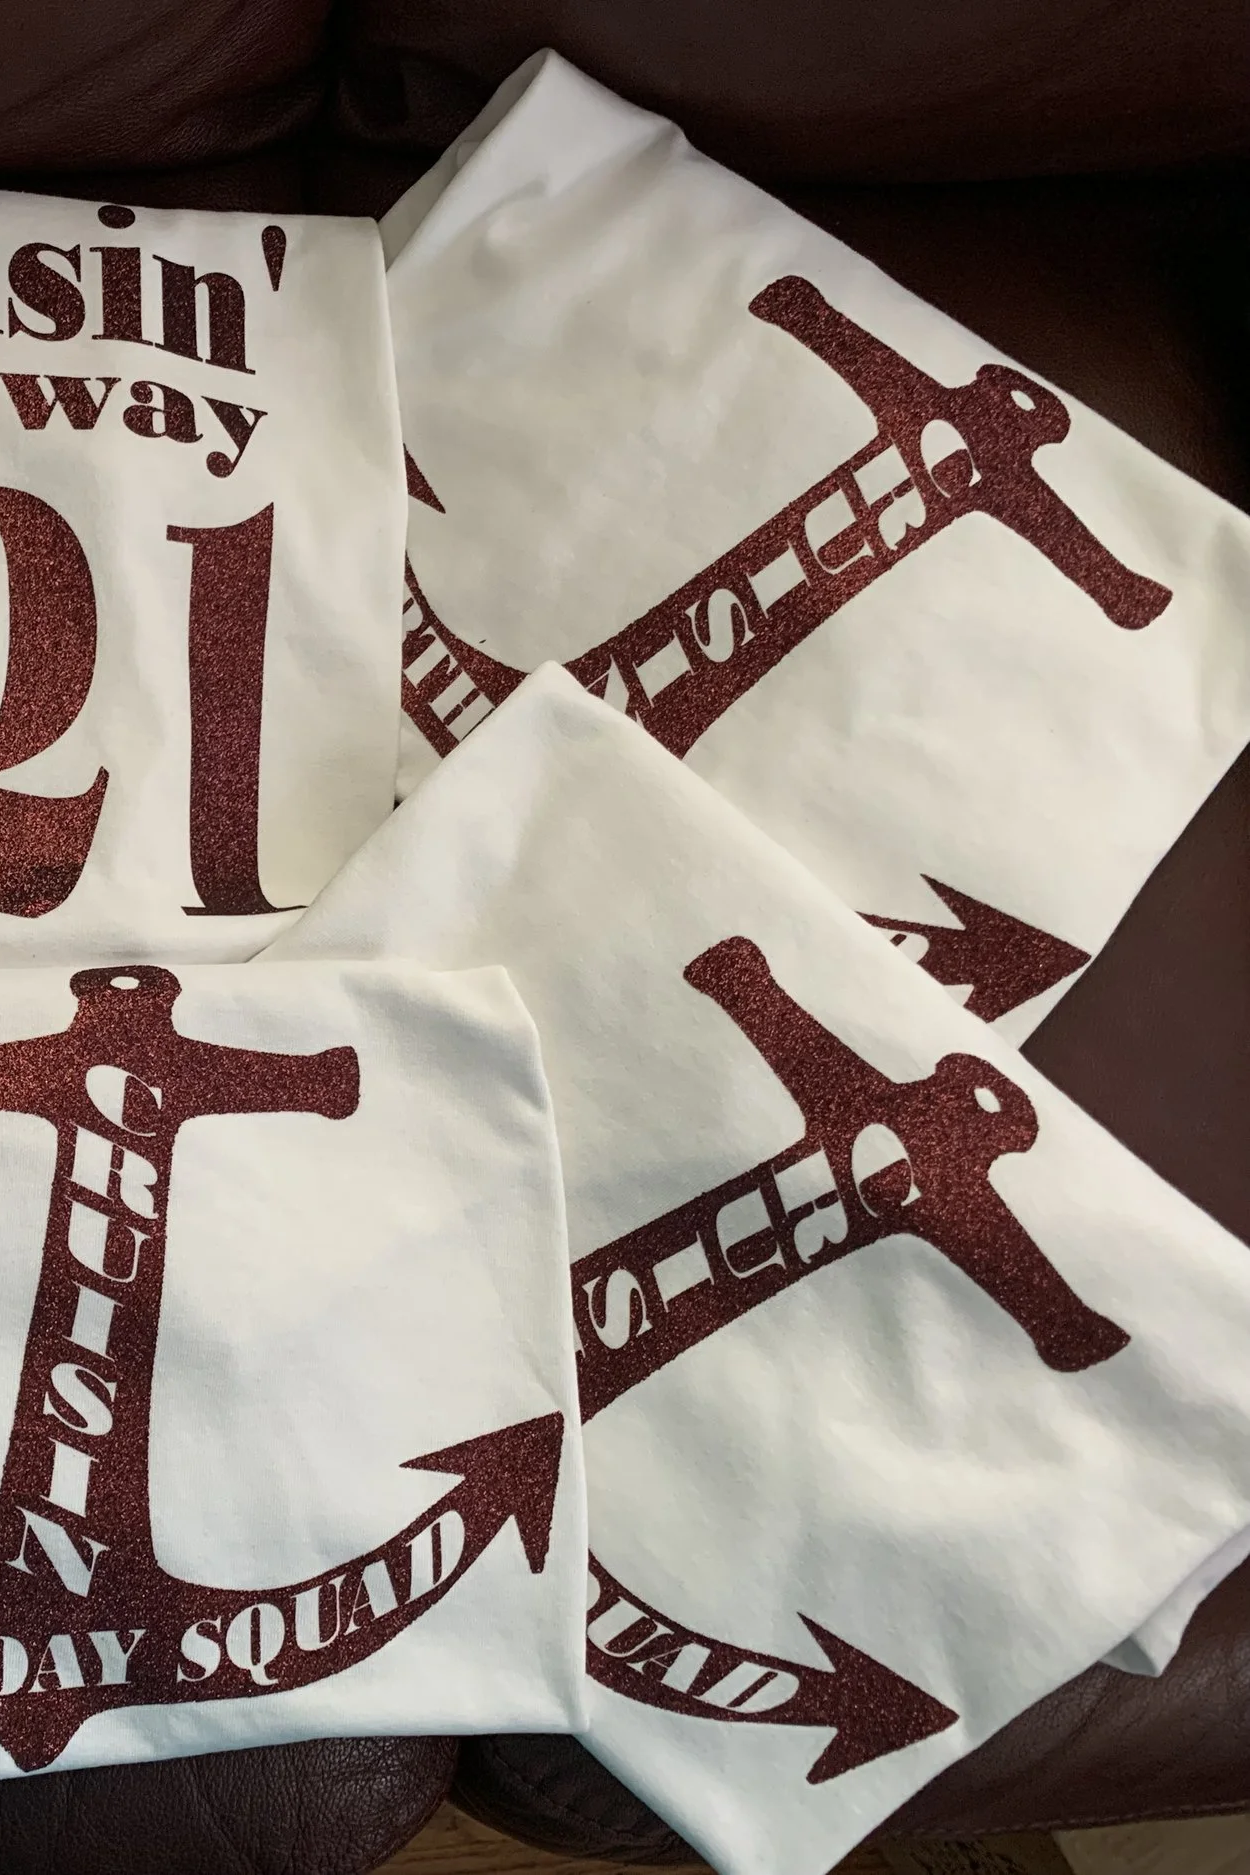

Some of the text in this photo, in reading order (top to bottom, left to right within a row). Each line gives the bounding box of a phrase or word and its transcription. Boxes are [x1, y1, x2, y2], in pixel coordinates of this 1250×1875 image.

[8, 1064, 163, 1597] CRUISIN
[574, 1123, 922, 1357] CRUIS
[177, 1509, 466, 1686] SQUAD
